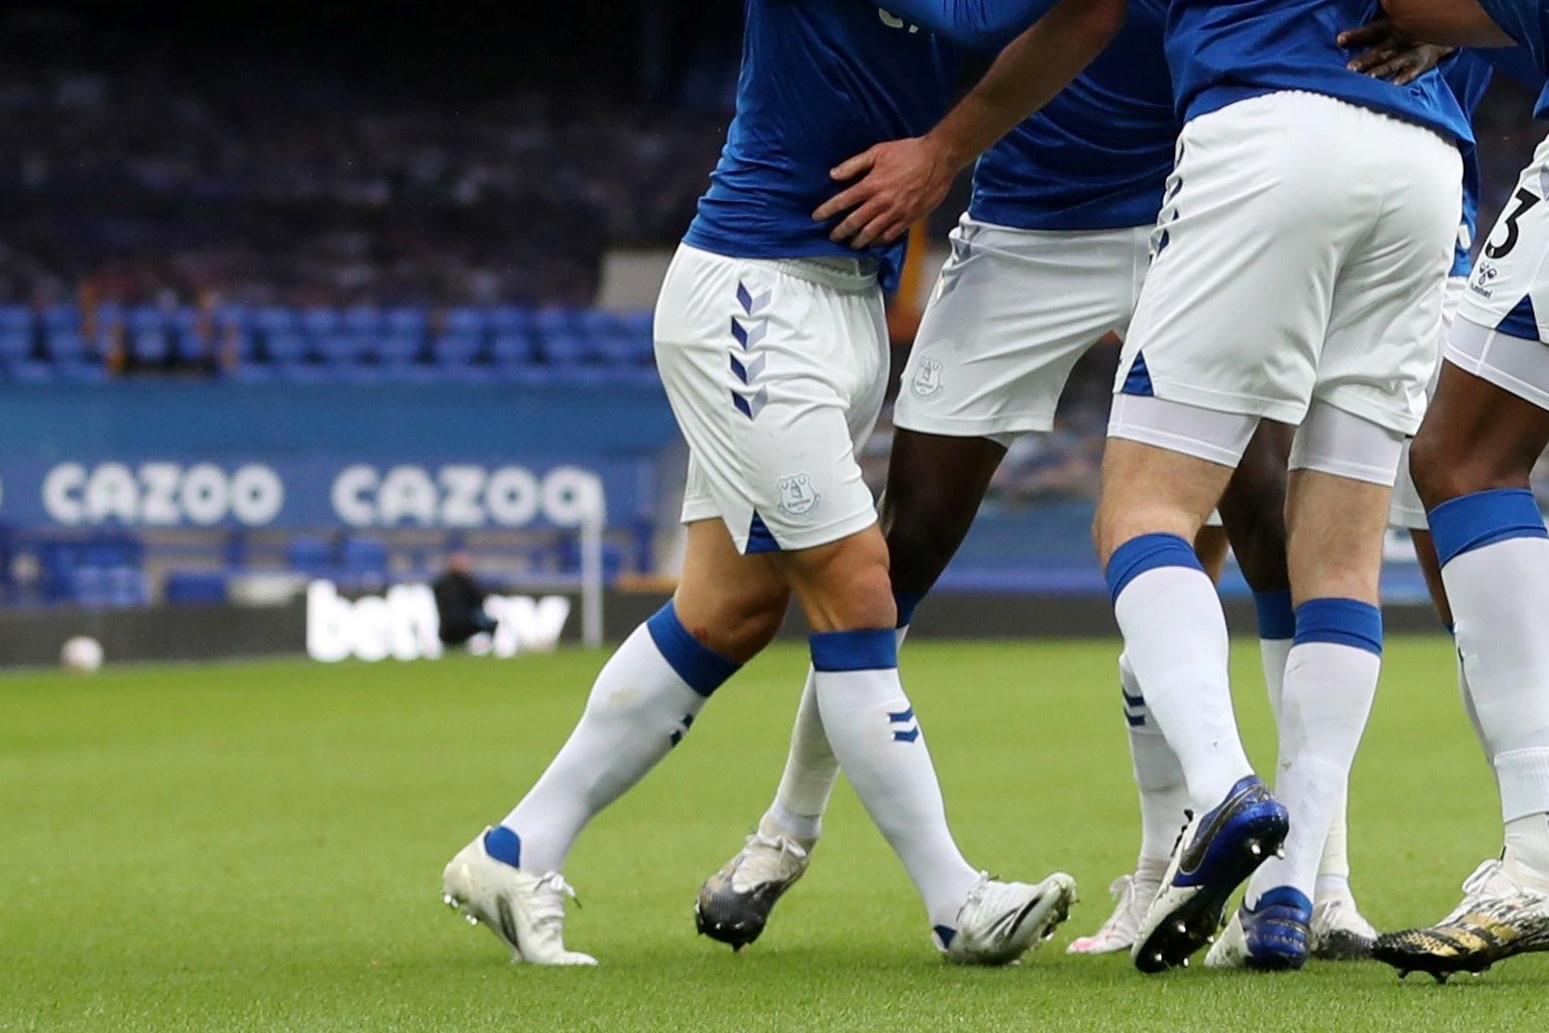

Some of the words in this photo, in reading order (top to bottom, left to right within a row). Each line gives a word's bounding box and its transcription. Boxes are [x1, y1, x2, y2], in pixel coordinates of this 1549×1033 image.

[1485, 187, 1541, 259] 3
[42, 463, 283, 526] CAZOO
[331, 465, 601, 527] CAZOO
